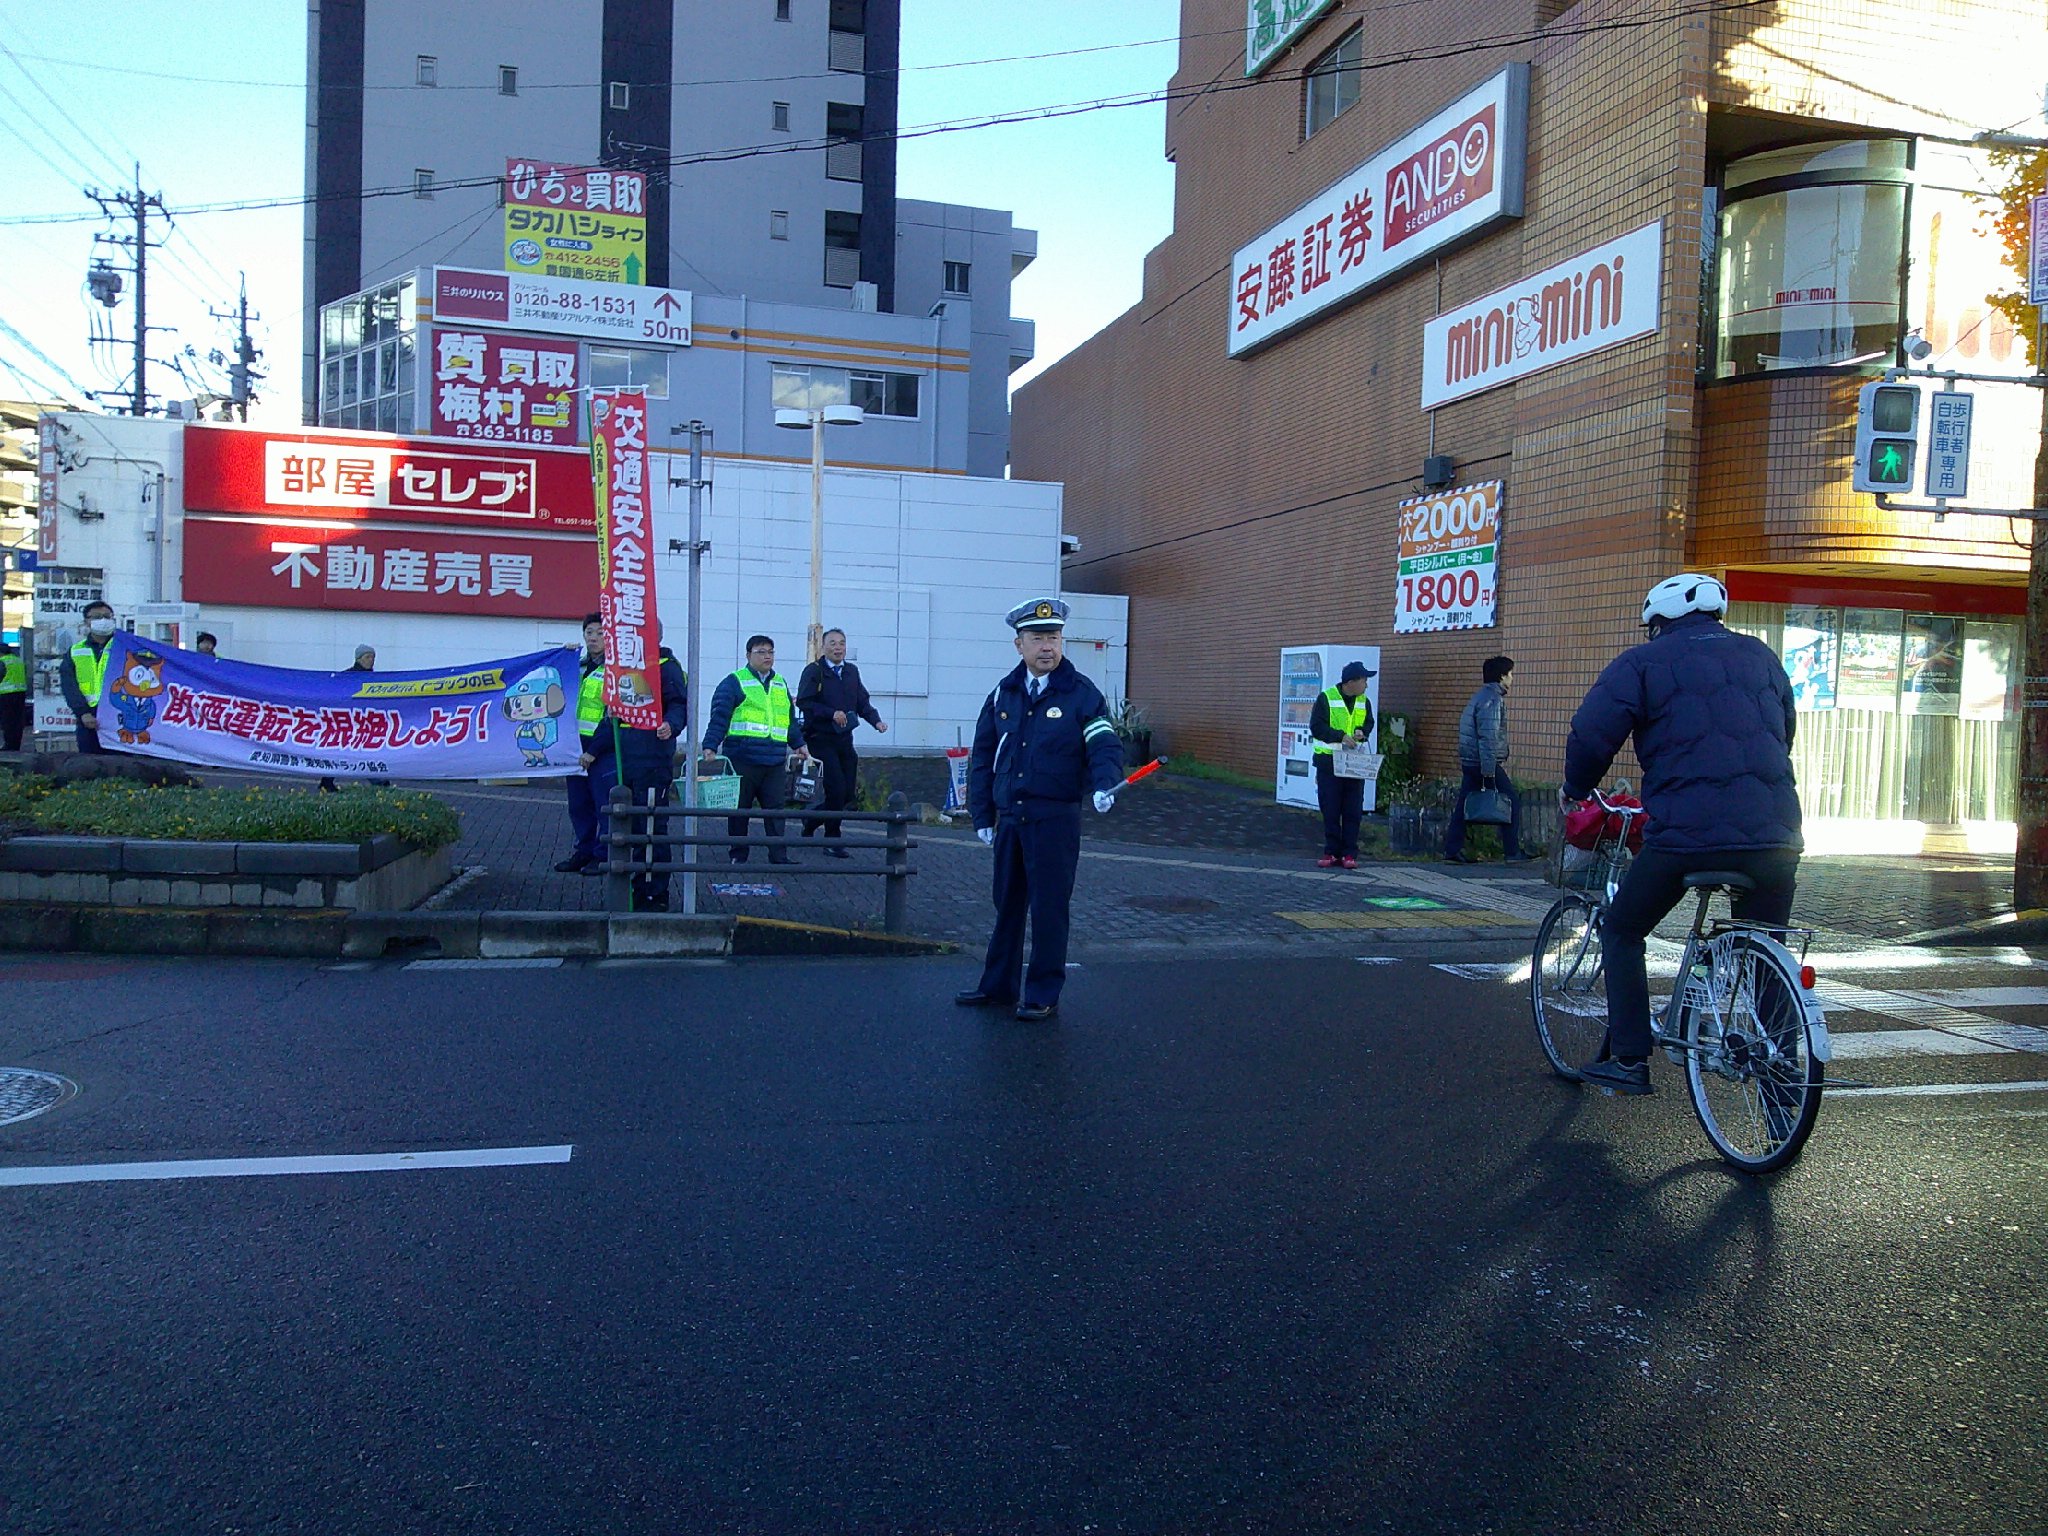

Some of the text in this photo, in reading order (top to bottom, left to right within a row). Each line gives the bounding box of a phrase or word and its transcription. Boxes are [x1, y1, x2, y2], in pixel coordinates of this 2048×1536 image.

[510, 163, 642, 214] ひちと買取
[1388, 121, 1489, 224] ANDO
[508, 209, 644, 242] タカハシライフ
[1404, 188, 1466, 233] SECURITIES
[1236, 187, 1373, 331] 安藤証券
[441, 285, 505, 301] 三井のリハウス
[514, 292, 635, 315] 0120-88-1531
[1775, 287, 1836, 304] mini mini
[514, 307, 635, 329] 三井不動産リアルティ株式会社
[642, 319, 689, 341] 50m
[1446, 255, 1624, 385] mini mini
[436, 333, 575, 388] 質 買取
[438, 382, 525, 425] 梅村
[1935, 401, 1951, 453] 自転車
[472, 424, 553, 443] 363-1185
[1950, 402, 1967, 453] 歩行者
[282, 455, 529, 505] 部屋 セレブ
[1939, 455, 1956, 489] 専用
[612, 404, 647, 671] 交通安全運動
[1403, 511, 1412, 542] 大人
[271, 541, 533, 598] 不動産売買
[161, 684, 491, 750] 飲酒運転を根絶しよう!
